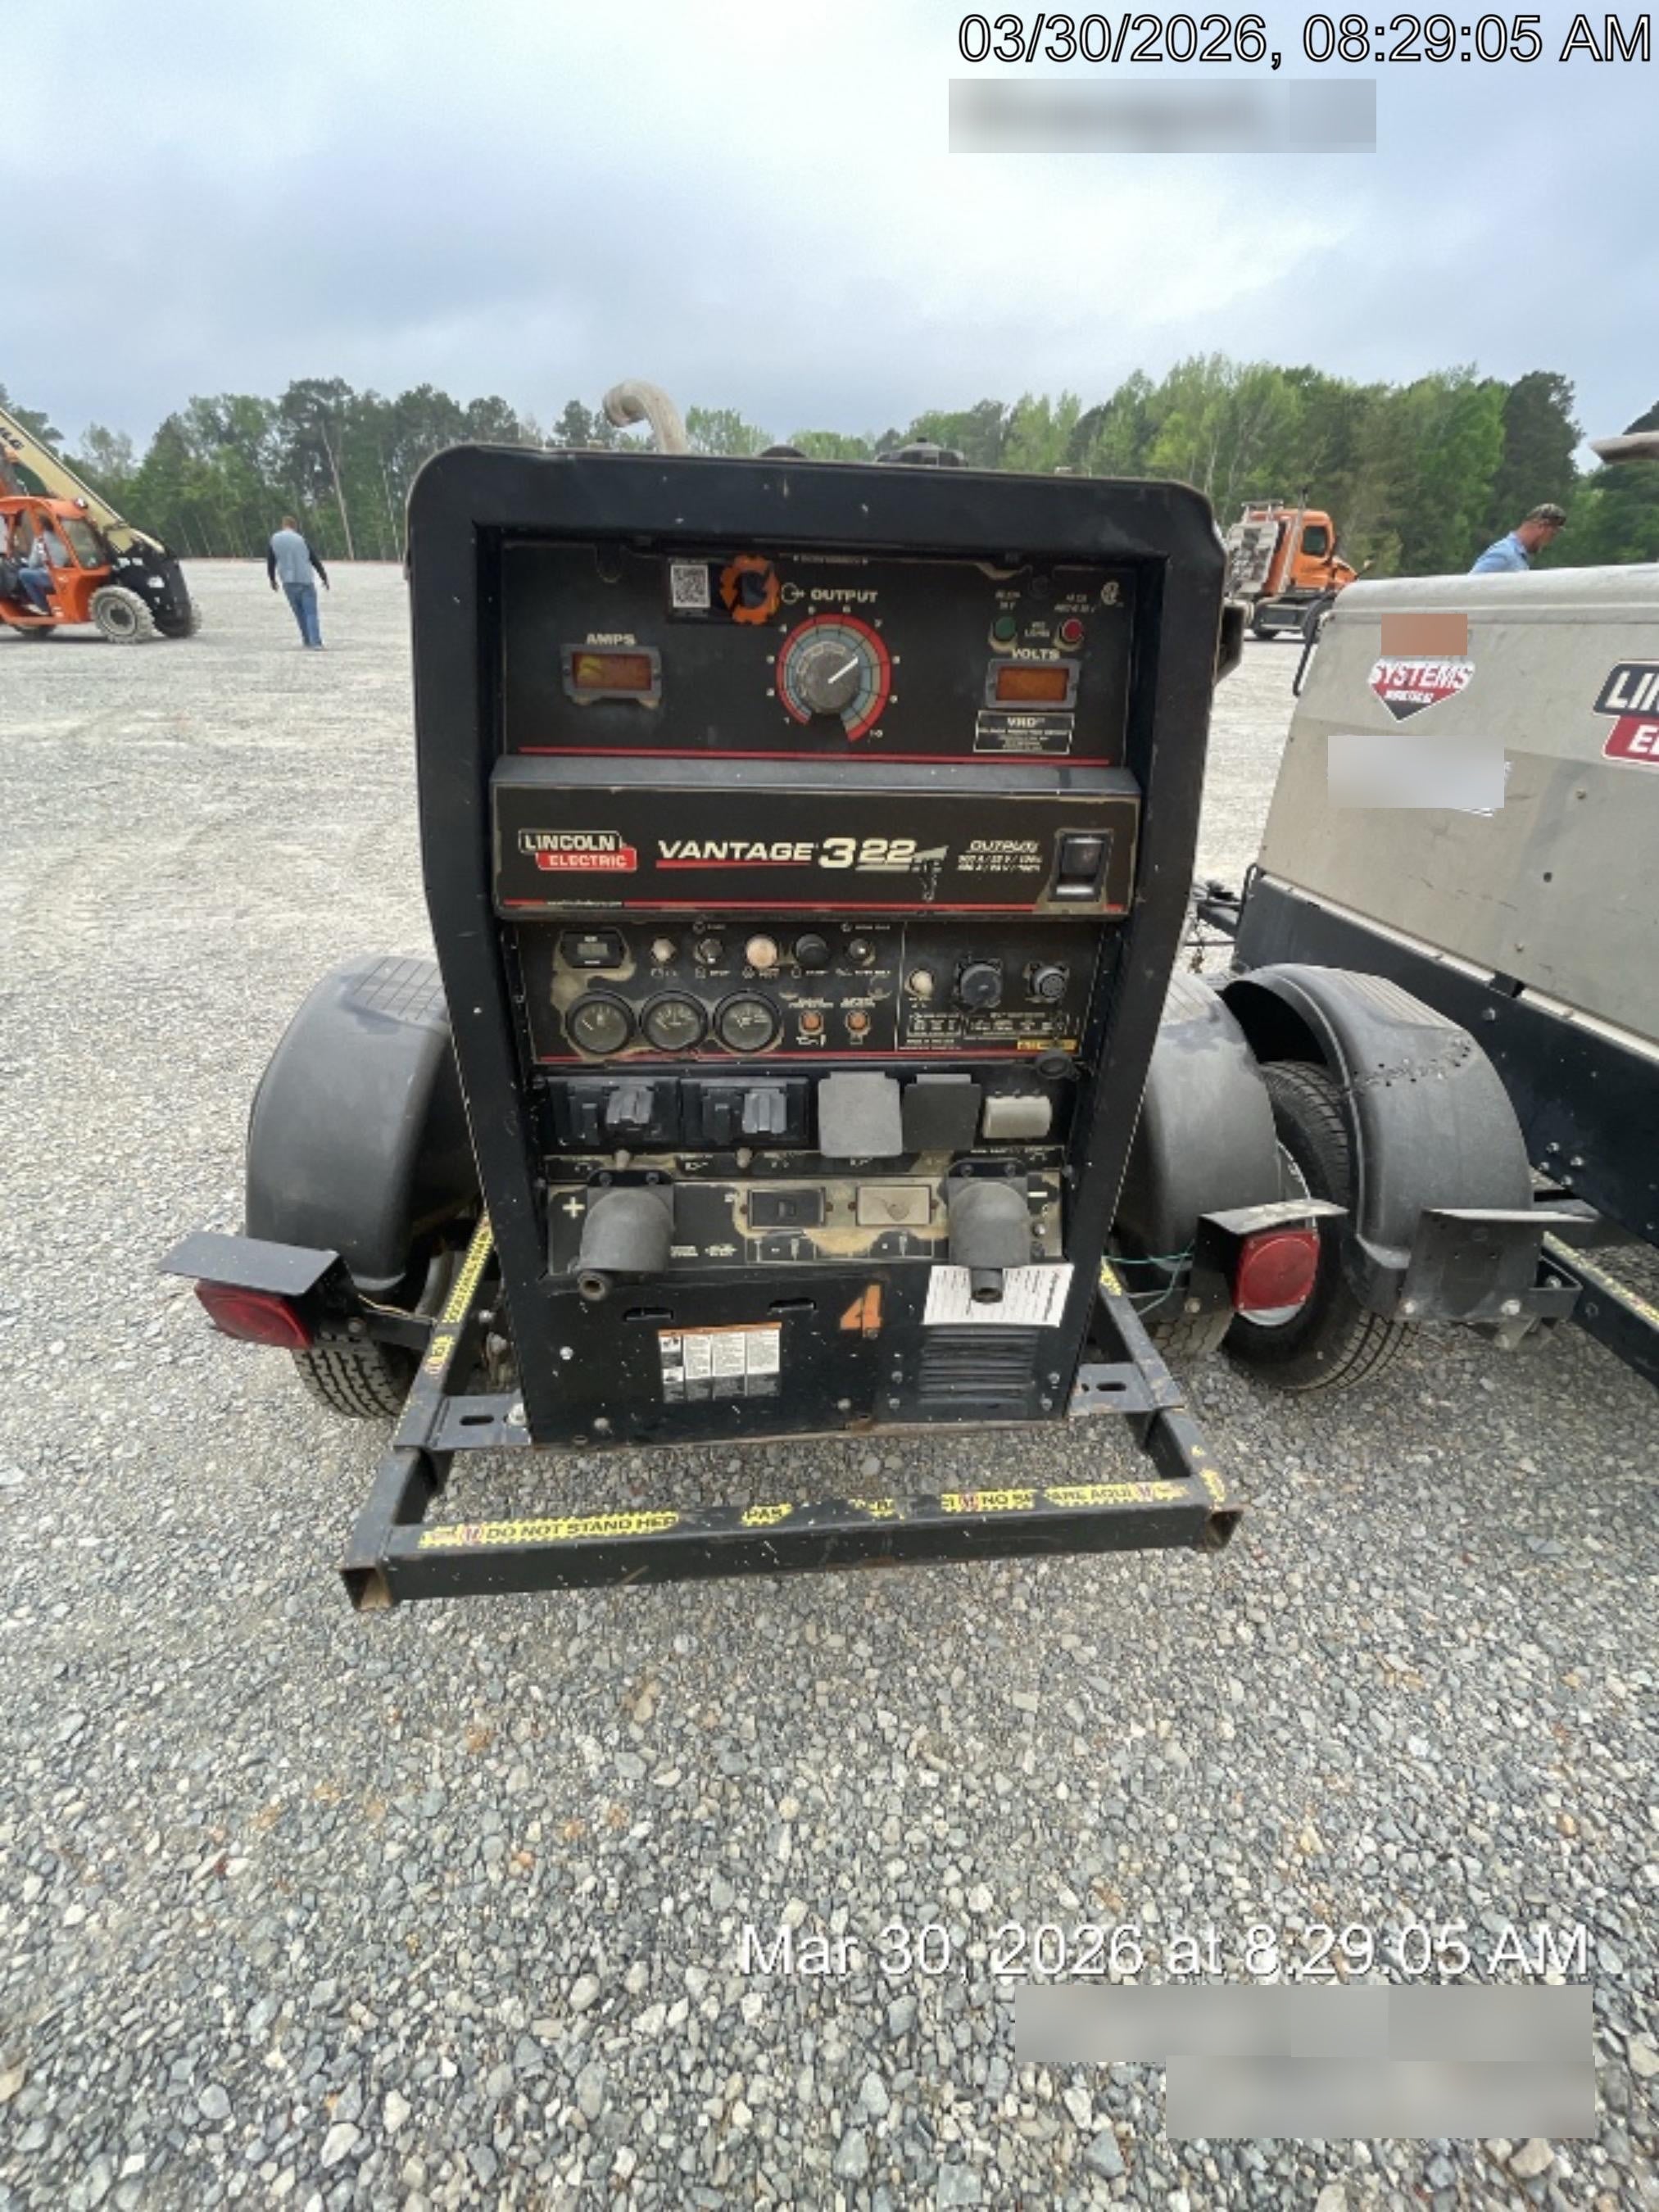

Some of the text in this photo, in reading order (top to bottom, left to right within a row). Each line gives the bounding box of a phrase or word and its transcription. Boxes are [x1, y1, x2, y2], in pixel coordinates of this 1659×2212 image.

[810, 588, 879, 603] OUTPUT
[586, 633, 637, 646] AMPS
[1011, 648, 1062, 662] VOLTS
[1370, 661, 1474, 690] SYSTEMS
[524, 834, 615, 851] LINCOLN
[549, 854, 628, 868] ELECTRIC
[658, 841, 814, 861] VANTAGE
[818, 837, 918, 868] 322
[840, 1284, 882, 1337] 4
[486, 1527, 516, 1539] DO
[521, 1522, 563, 1536] NOT
[566, 1517, 632, 1534] STAND
